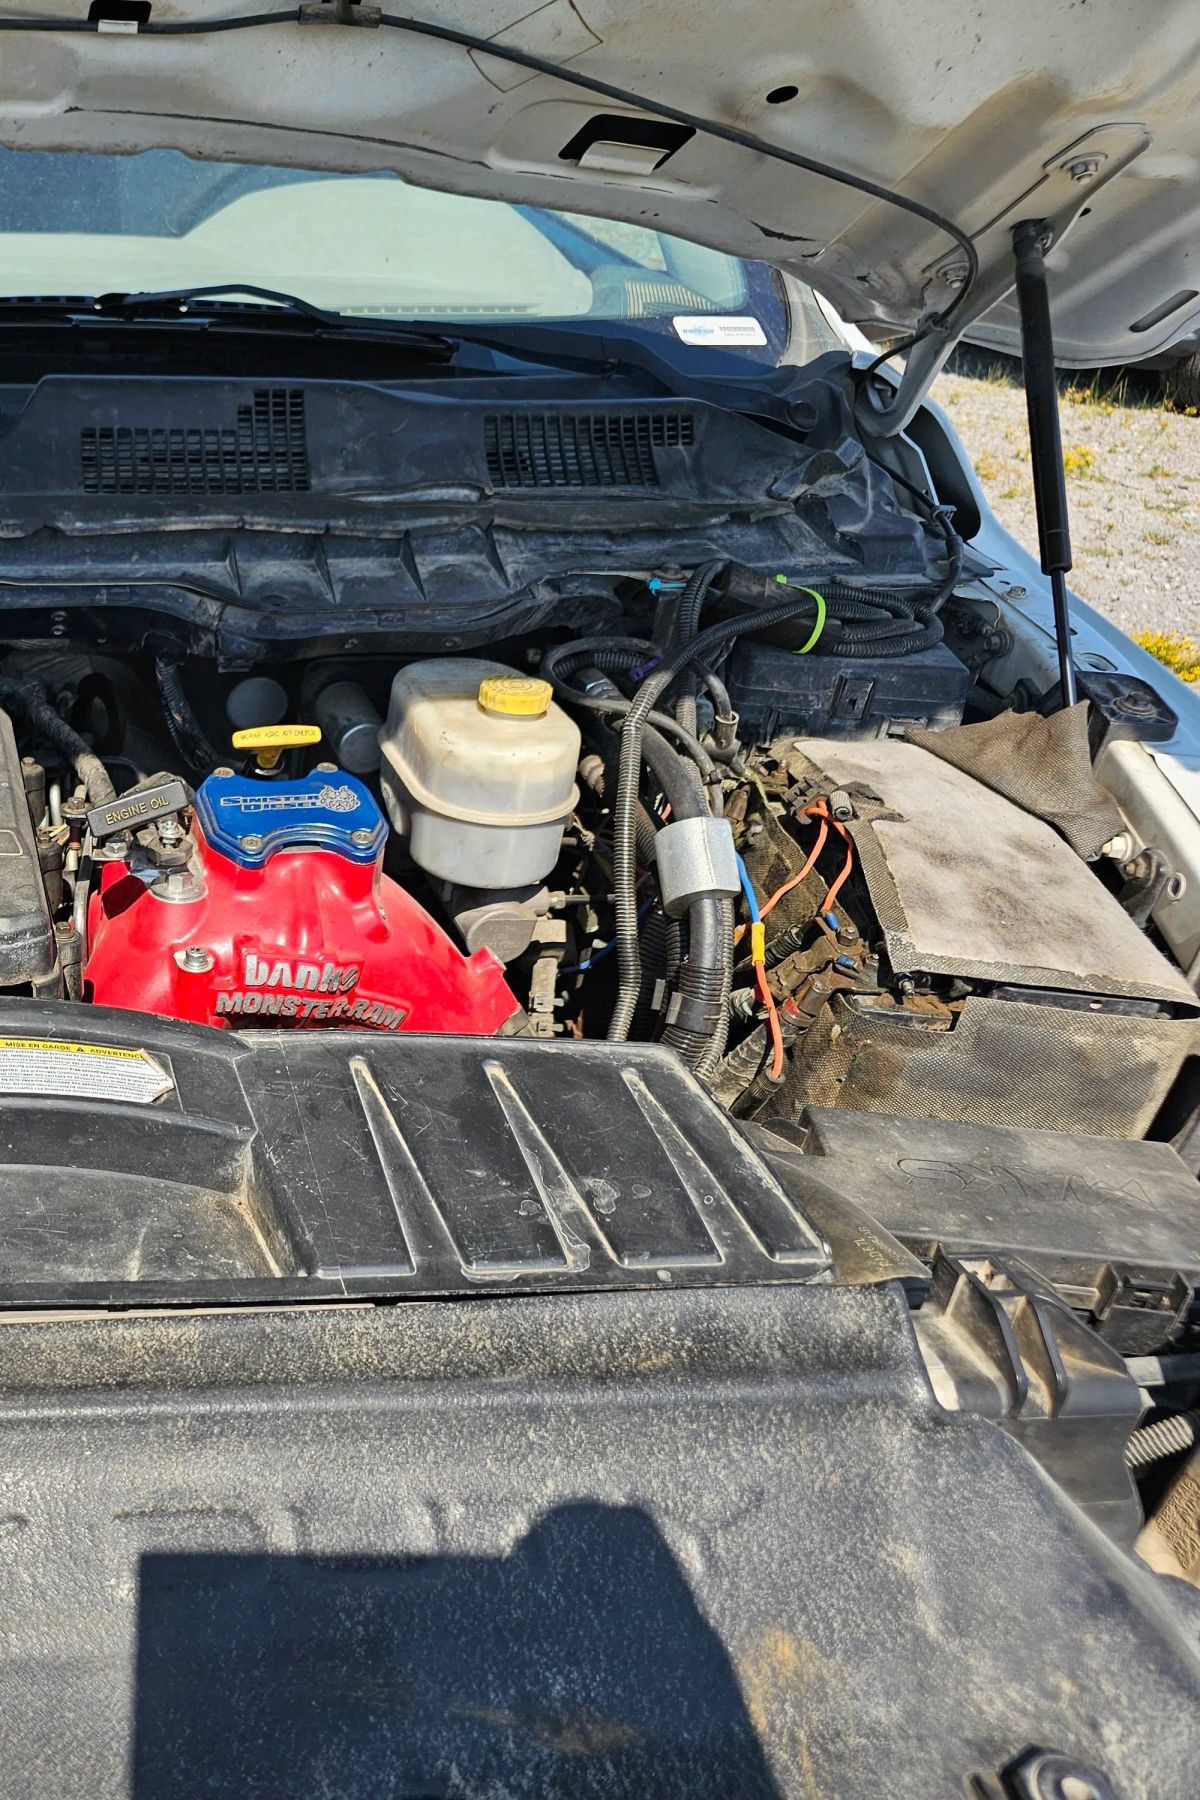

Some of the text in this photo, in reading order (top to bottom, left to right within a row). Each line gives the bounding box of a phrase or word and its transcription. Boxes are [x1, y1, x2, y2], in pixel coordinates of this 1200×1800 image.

[220, 793, 322, 807] SINISTER
[105, 794, 170, 825] ENGINE OIL
[240, 802, 324, 813] DIESEL
